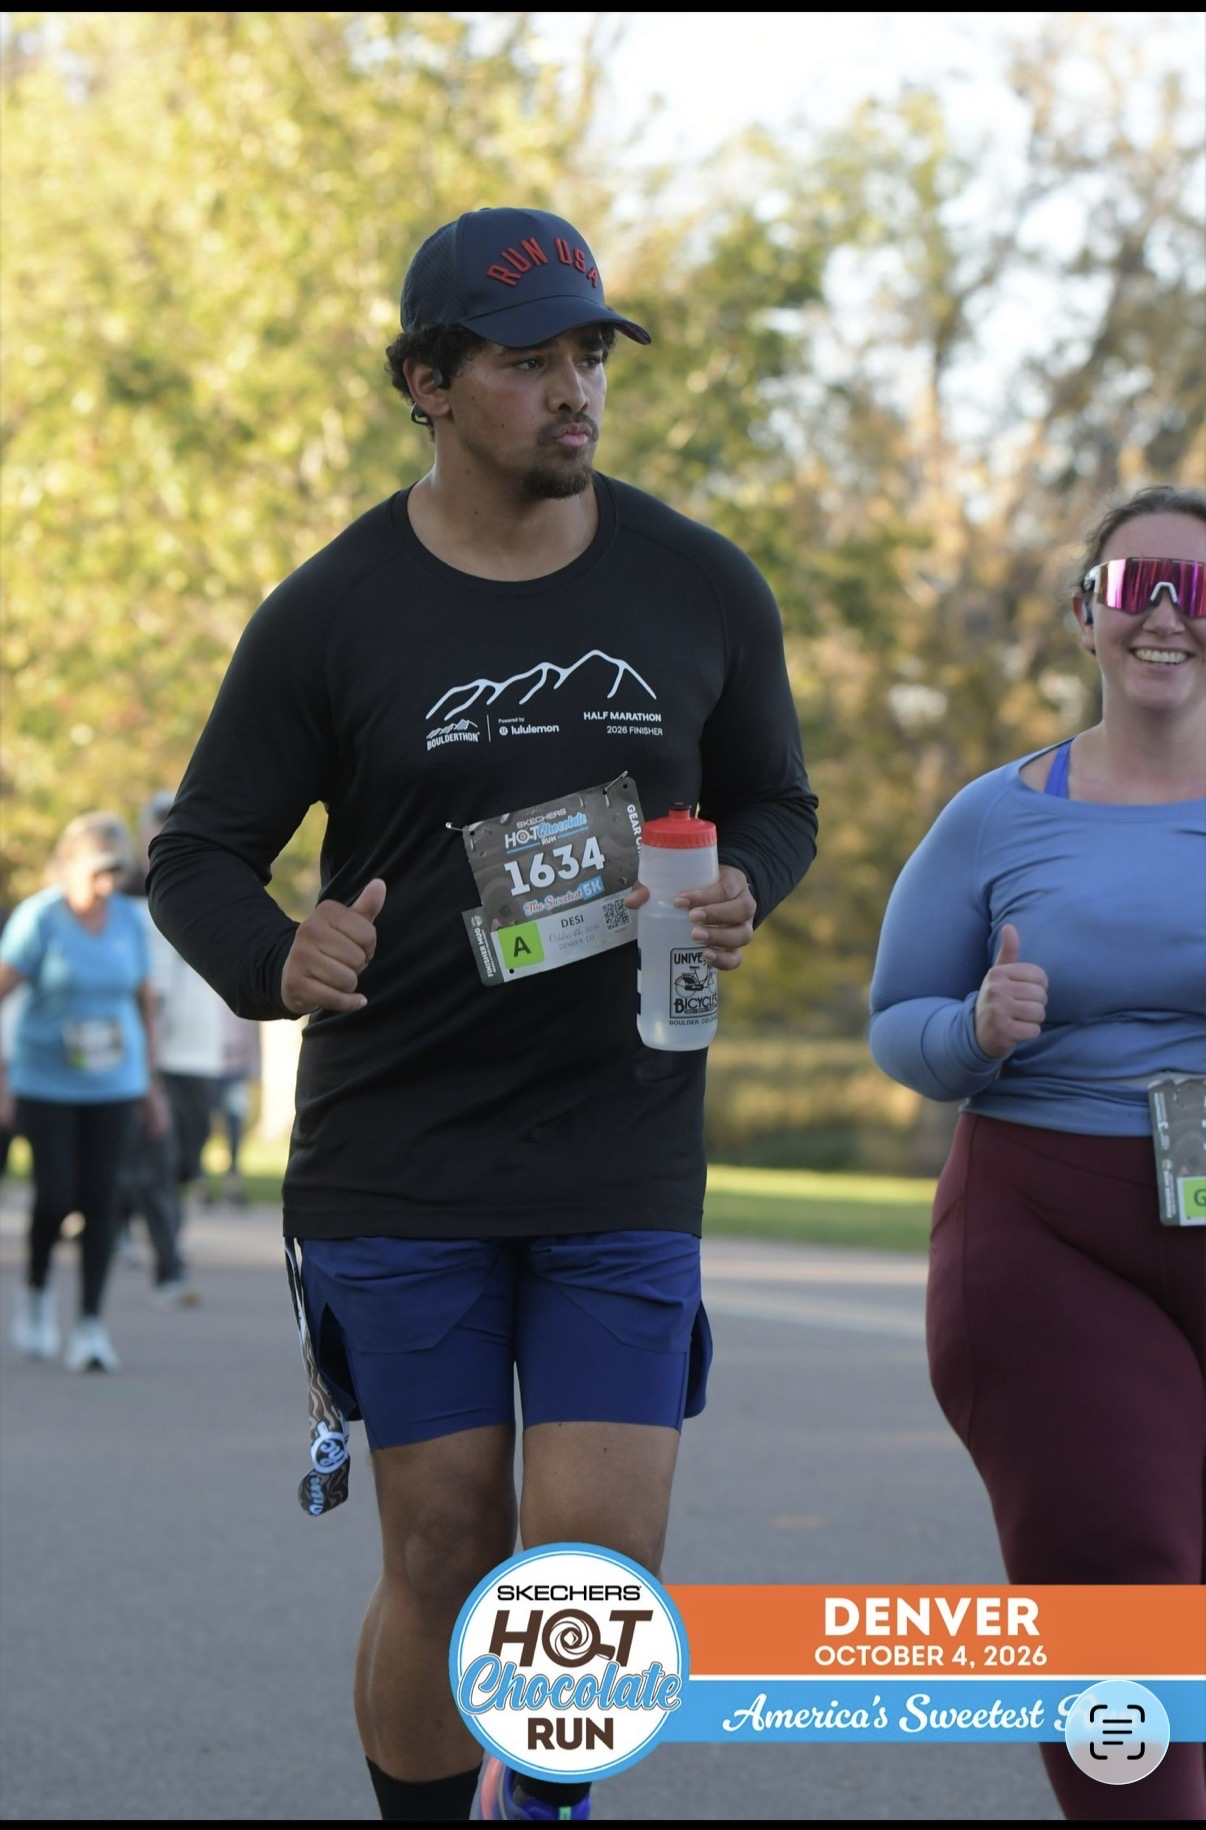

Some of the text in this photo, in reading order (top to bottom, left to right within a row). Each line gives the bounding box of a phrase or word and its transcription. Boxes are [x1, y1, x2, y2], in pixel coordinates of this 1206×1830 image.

[486, 236, 599, 288] RUN USA
[583, 711, 662, 722] HALF MARATHON
[511, 724, 560, 735] lululemon
[606, 725, 663, 736] 2026 FINISHER
[426, 732, 479, 751] BOULDERTHON
[516, 808, 567, 829] SKECHERS
[627, 804, 642, 836] GEAR
[504, 812, 588, 849] HOT Chocolate
[541, 835, 557, 846] RUN
[503, 836, 606, 896] 1634
[523, 899, 544, 916] The
[544, 888, 582, 911] Sweetest
[582, 878, 602, 897] 5K
[561, 914, 584, 929] DESI
[474, 927, 484, 945] MUG
[513, 935, 532, 957] A
[480, 944, 494, 978] FINISHER
[674, 952, 706, 965] UNIVE
